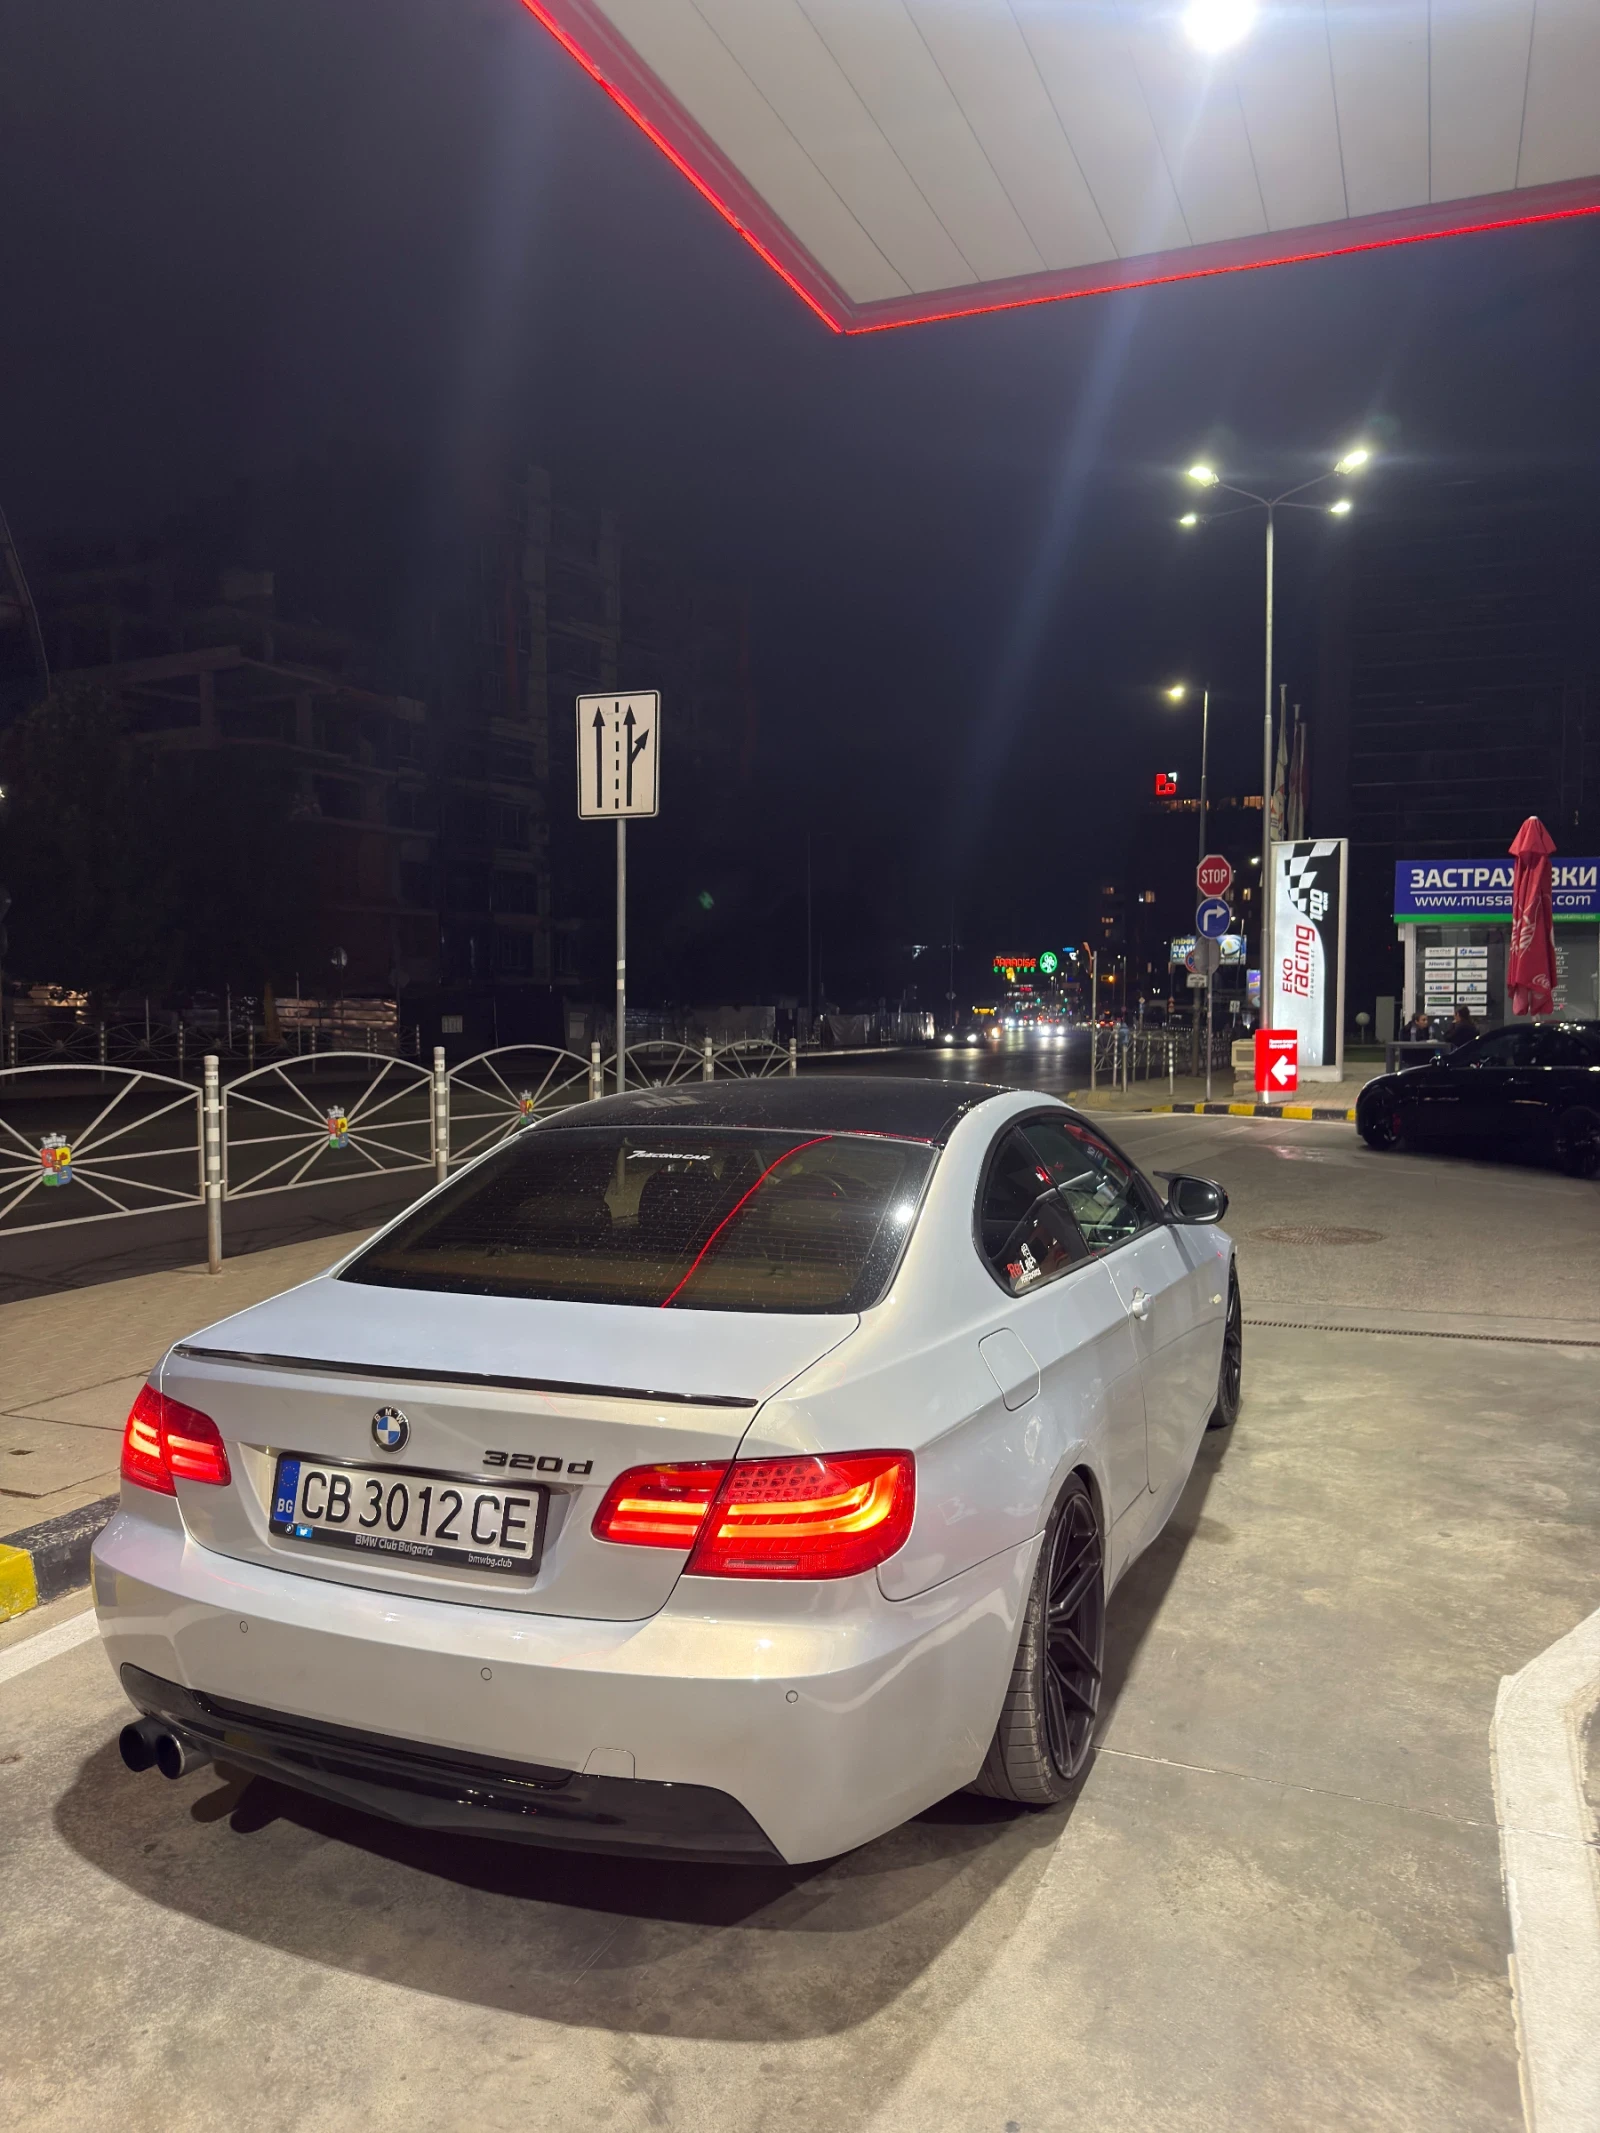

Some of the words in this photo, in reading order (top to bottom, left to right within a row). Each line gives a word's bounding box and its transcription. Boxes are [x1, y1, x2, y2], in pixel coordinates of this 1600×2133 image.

[1201, 869, 1228, 884] STOP
[1410, 866, 1597, 889] ЗАСТРАВКИ
[1310, 888, 1323, 921] 100
[993, 958, 1036, 967] PARADISE
[1294, 924, 1316, 998] racing
[1282, 958, 1294, 993] EKO
[483, 1450, 594, 1475] 320d
[276, 1498, 294, 1514] BG
[301, 1471, 352, 1523] CB
[358, 1480, 464, 1541] 3012
[471, 1493, 532, 1550] CE
[355, 1534, 378, 1547] BMW
[378, 1538, 397, 1551] Club
[398, 1541, 434, 1557] Bulgaria
[468, 1553, 513, 1568] bmwbg.club
